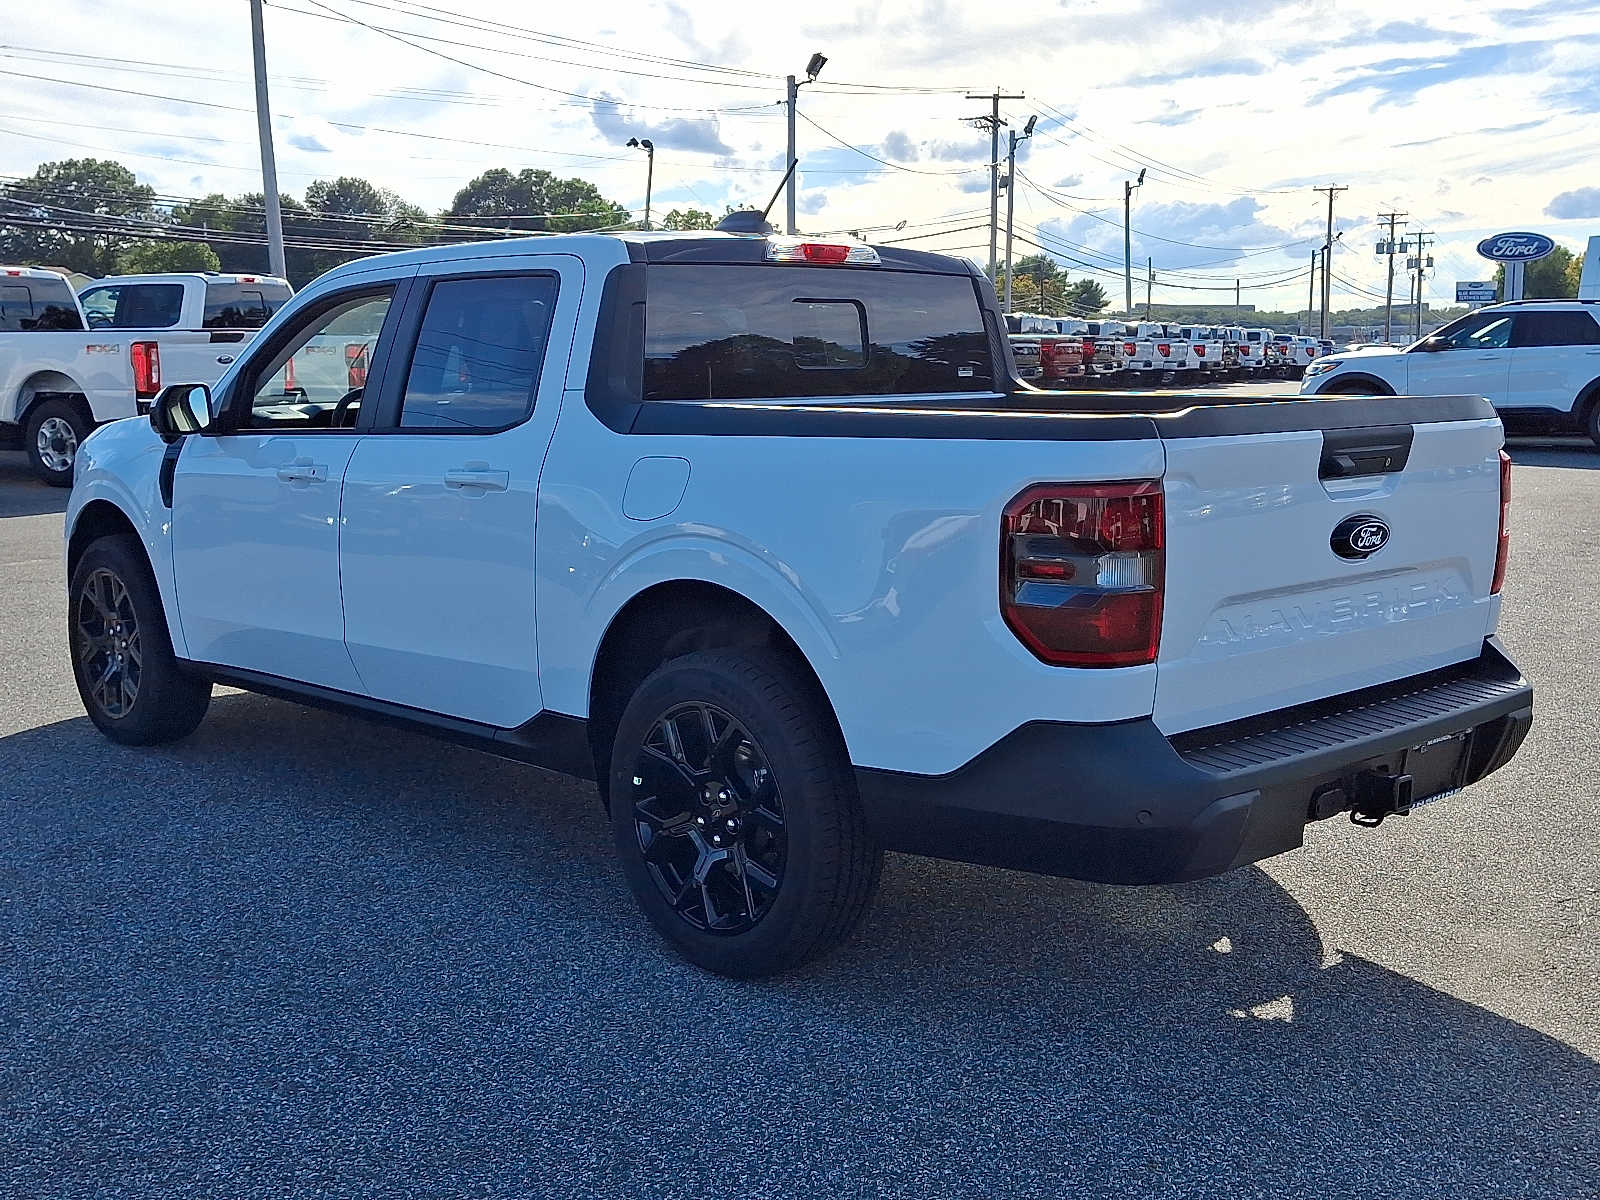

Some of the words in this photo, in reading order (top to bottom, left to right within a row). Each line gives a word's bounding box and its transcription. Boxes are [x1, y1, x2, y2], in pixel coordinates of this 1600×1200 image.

[1492, 237, 1540, 256] Ford
[1358, 527, 1383, 547] Ford
[1198, 576, 1459, 644] MAVERICK
